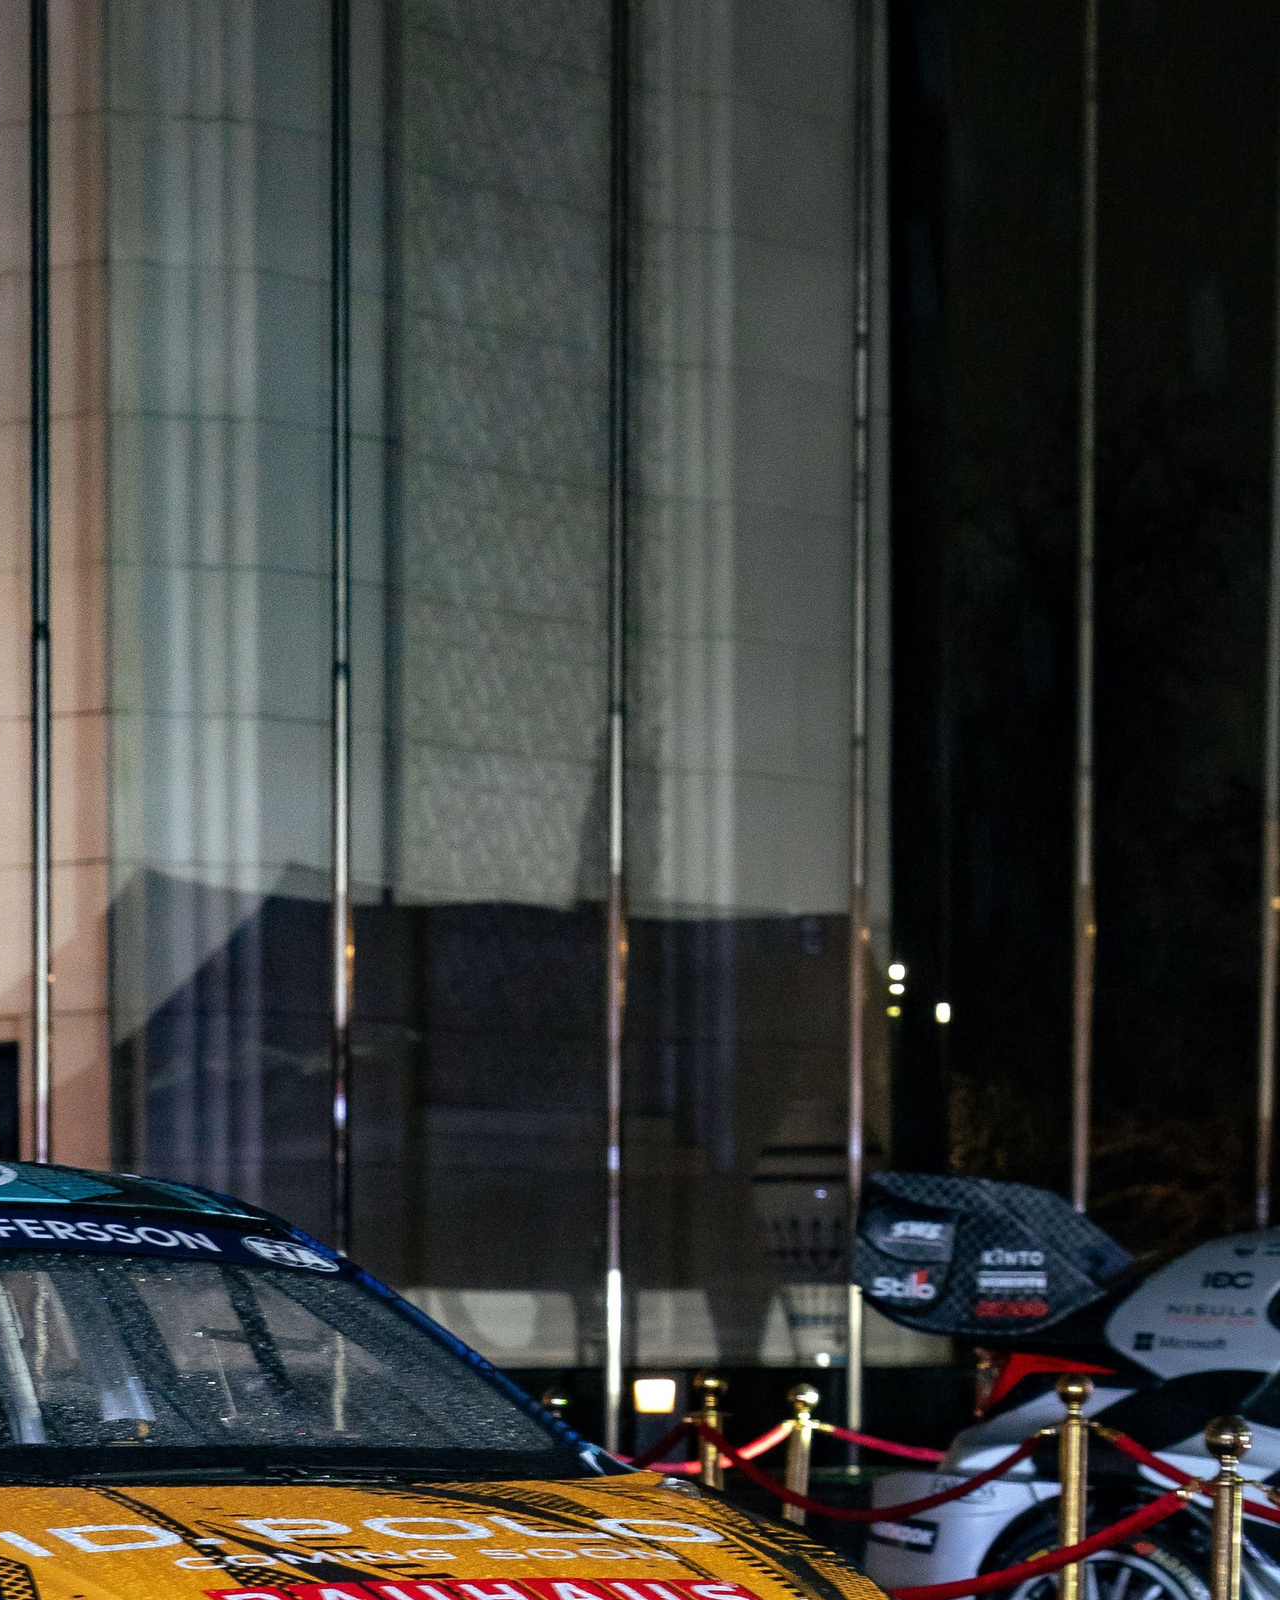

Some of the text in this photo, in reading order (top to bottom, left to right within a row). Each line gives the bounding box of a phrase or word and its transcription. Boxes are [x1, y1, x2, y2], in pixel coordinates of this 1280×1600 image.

[235, 1515, 725, 1544] POLO
[174, 1547, 682, 1570] COMING SOON
